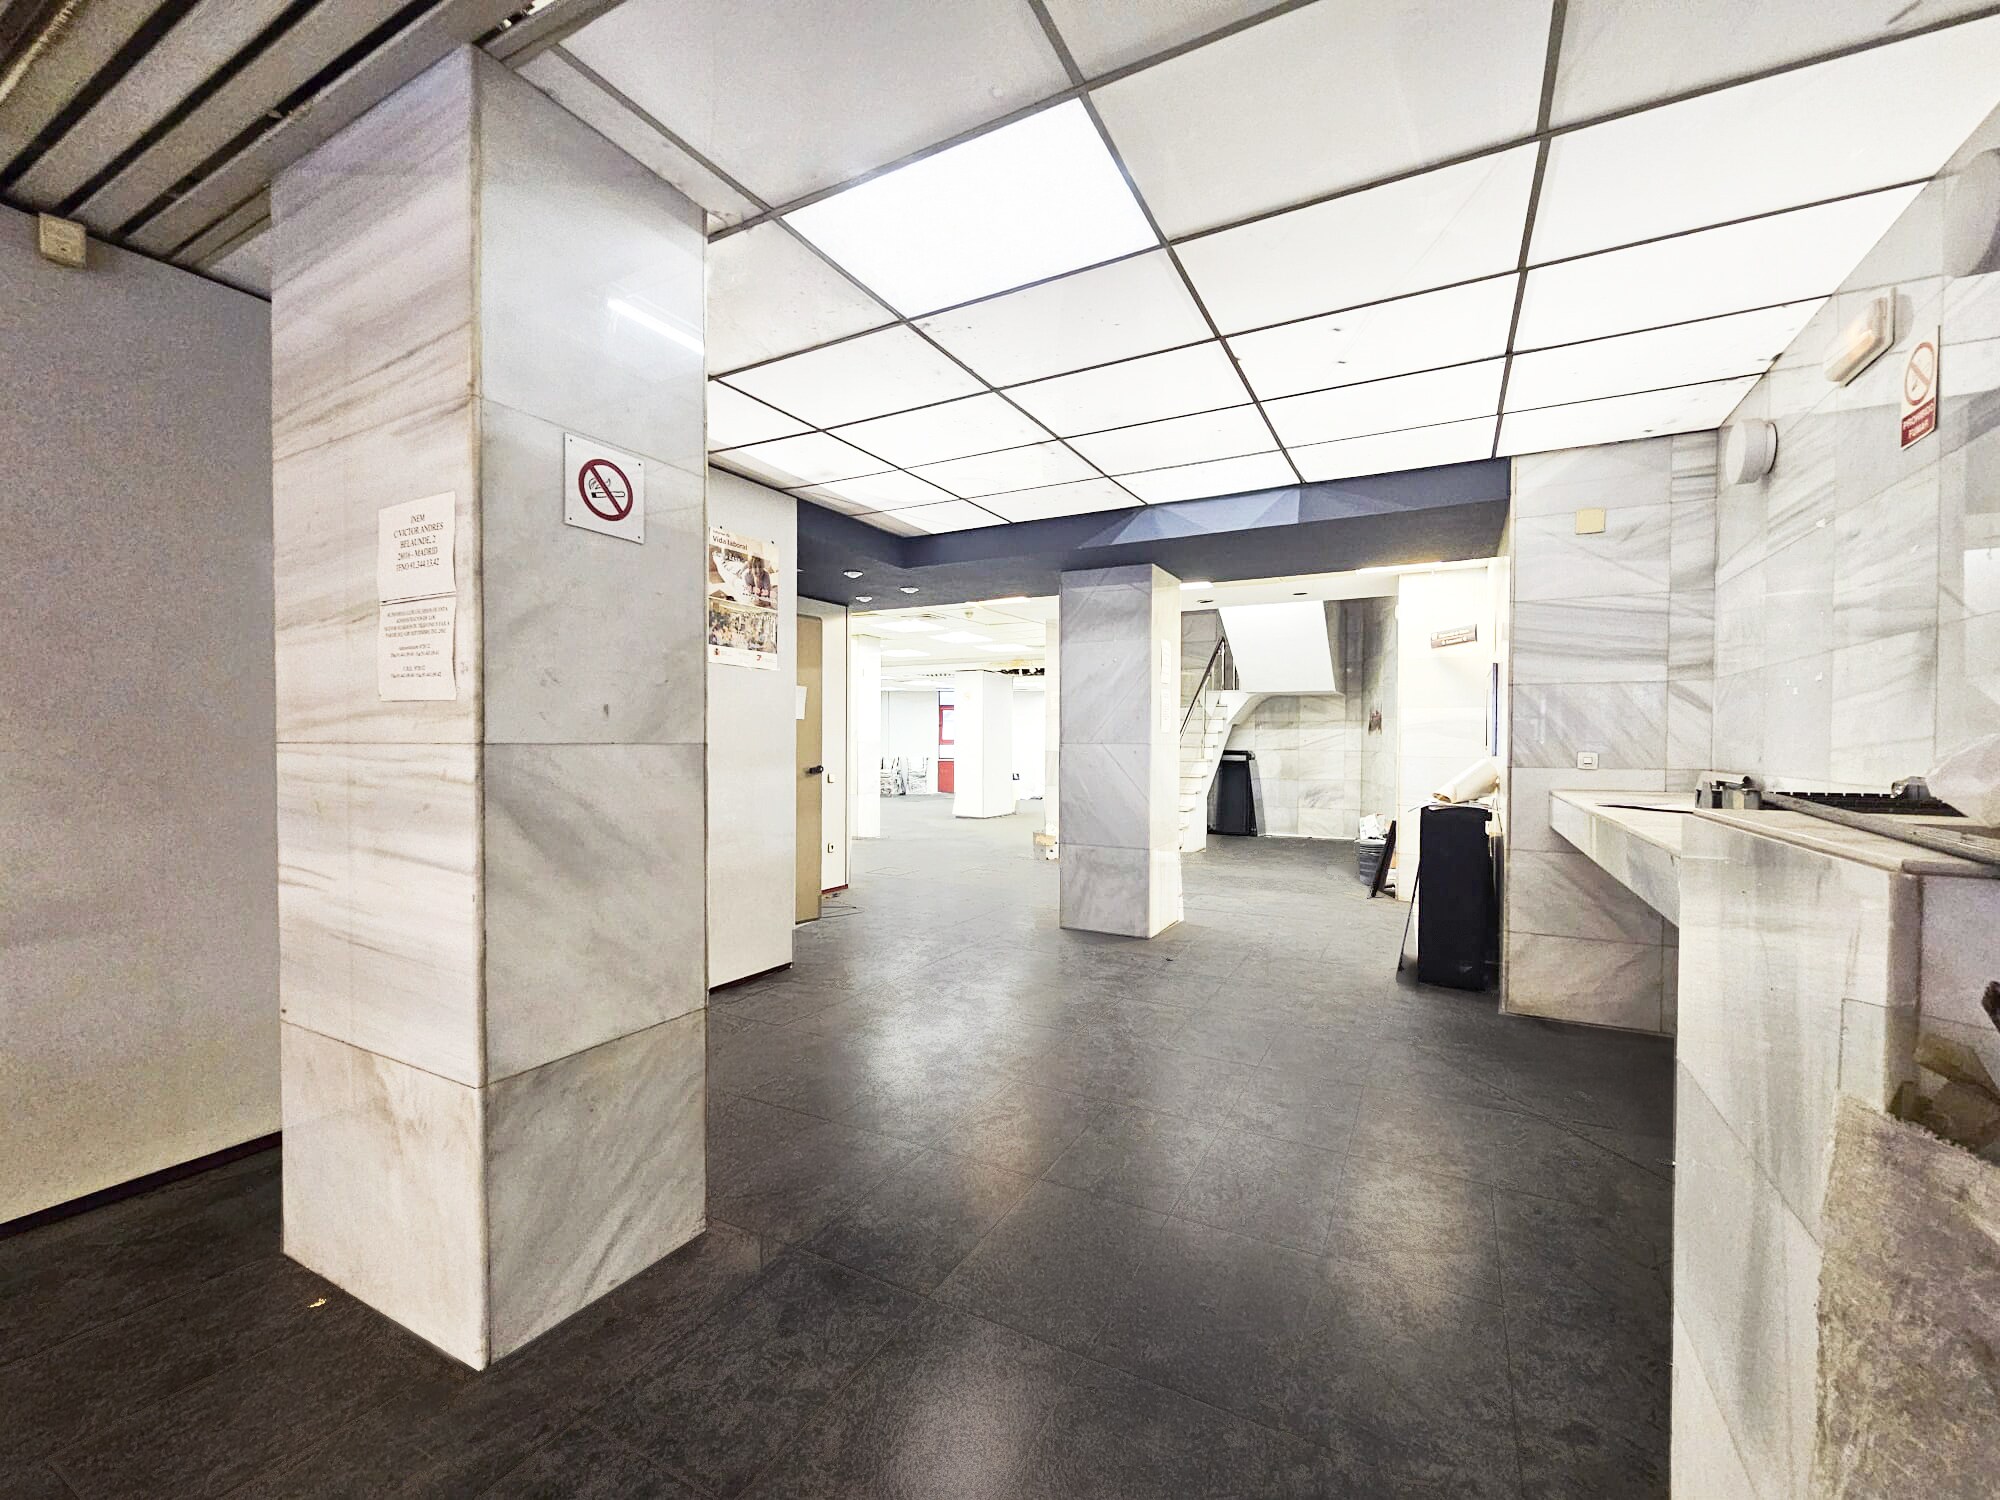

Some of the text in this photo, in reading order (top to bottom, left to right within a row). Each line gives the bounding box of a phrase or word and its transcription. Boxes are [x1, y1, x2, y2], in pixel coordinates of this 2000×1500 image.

[713, 535, 748, 550] Vida laboral
[414, 546, 438, 557] MADRID
